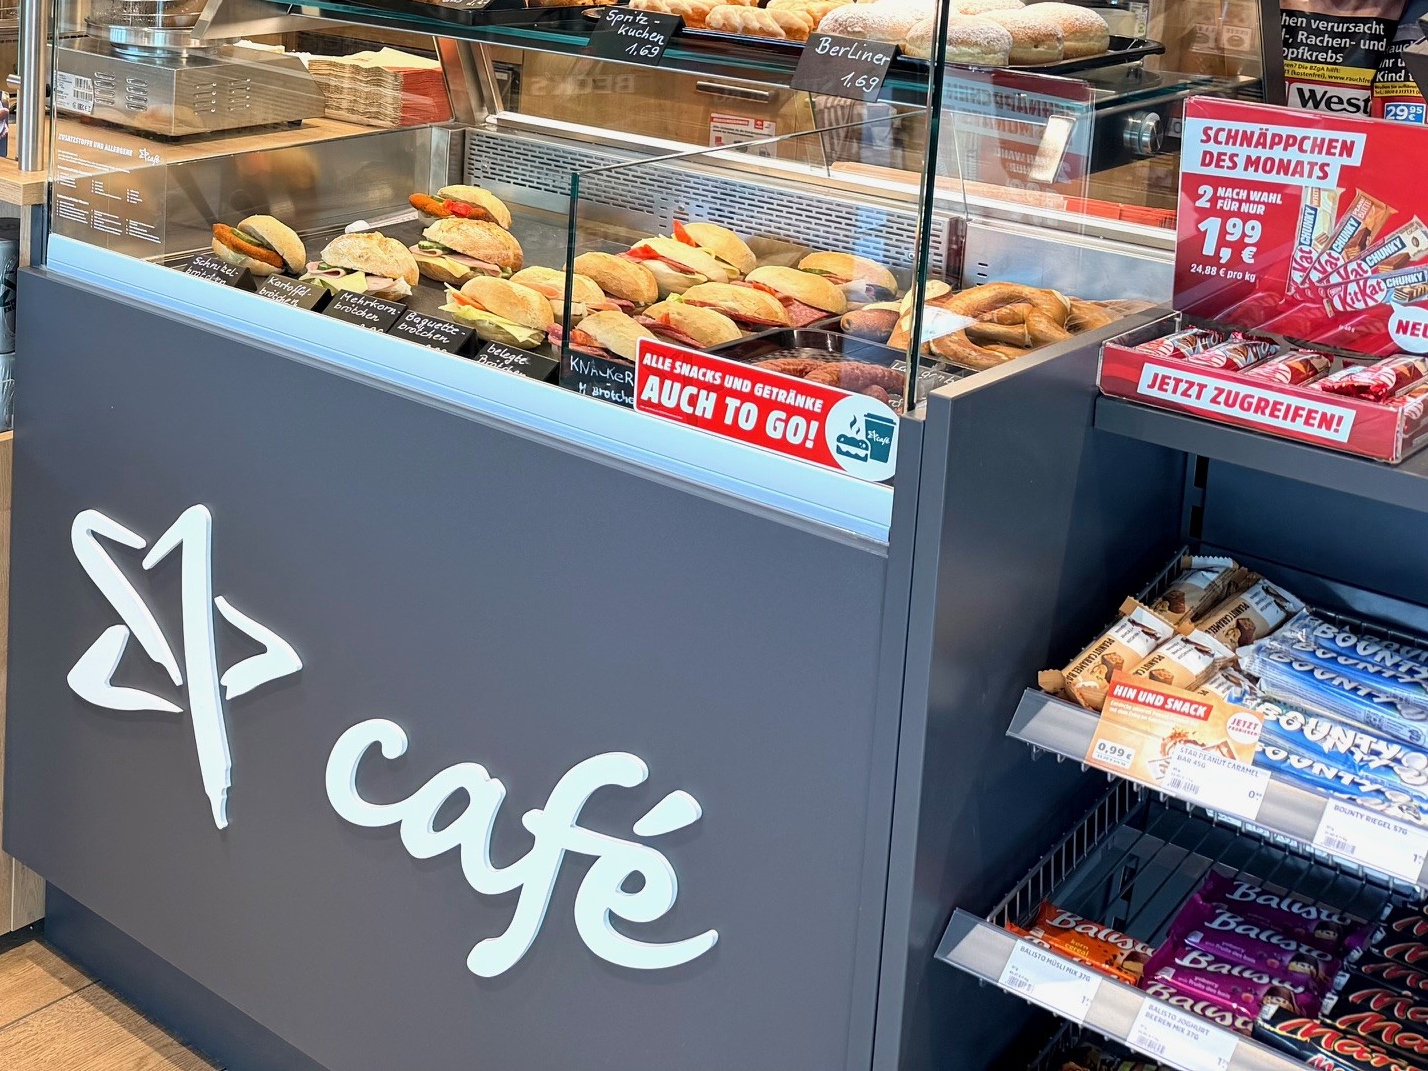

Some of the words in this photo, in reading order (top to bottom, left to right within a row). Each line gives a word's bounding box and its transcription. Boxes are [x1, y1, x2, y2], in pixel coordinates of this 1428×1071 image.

[1310, 17, 1384, 35] verursacht
[625, 43, 660, 58] 1,69
[1298, 31, 1356, 48] Rachen-
[1360, 37, 1386, 51] und
[841, 71, 880, 93] 1,69
[1376, 70, 1405, 82] Kind
[1296, 87, 1371, 115] West
[1200, 126, 1356, 159] SCHNÄPPCHEN
[1200, 150, 1239, 170] DES
[1243, 155, 1330, 180] MONATS
[1196, 185, 1214, 208] 2
[1217, 187, 1248, 203] NACH
[1249, 190, 1283, 205] WAHL
[1216, 199, 1240, 212] FÜR
[1241, 202, 1265, 215] NUR
[1300, 207, 1316, 245] CHUNKY
[1332, 217, 1359, 253] CHUNKY
[1365, 238, 1403, 267] CHUNKY
[1386, 272, 1423, 288] CHUNKY
[1190, 263, 1216, 275] 24,88
[1227, 271, 1241, 280] pro
[1242, 271, 1256, 283] kg
[1334, 278, 1385, 311] KitKat
[642, 352, 672, 371] ALLE
[674, 361, 722, 384] SNACKS
[724, 375, 752, 393] UND
[754, 382, 824, 413] GETRÄNKE
[640, 375, 717, 419] AUCH
[724, 397, 759, 431] TO
[765, 410, 820, 450] GO!
[1147, 372, 1209, 400] JETZT
[1211, 386, 1344, 434] ZUGREIFEN!
[1113, 684, 1137, 701] HIN
[1137, 689, 1163, 706] UND
[1165, 698, 1208, 718] SNACK
[1231, 717, 1259, 730] JETZT
[1097, 742, 1125, 757] 0,99
[1177, 756, 1191, 765] BAR
[1180, 747, 1198, 758] STAR
[1199, 752, 1226, 767] PEANUT
[1226, 760, 1259, 777] CARAMEL
[1366, 814, 1393, 830] RIEGEL
[325, 718, 719, 978] café
[1020, 945, 1046, 964] BALISTO
[1046, 956, 1067, 974] MÜSLI
[1067, 967, 1078, 977] MIX
[1064, 942, 1089, 958] cereal
[1145, 1011, 1172, 1028] BEEREN
[1173, 1022, 1185, 1034] MIX
[1148, 1004, 1175, 1021] BALISTO
[1177, 1016, 1210, 1036] JOGHURT
